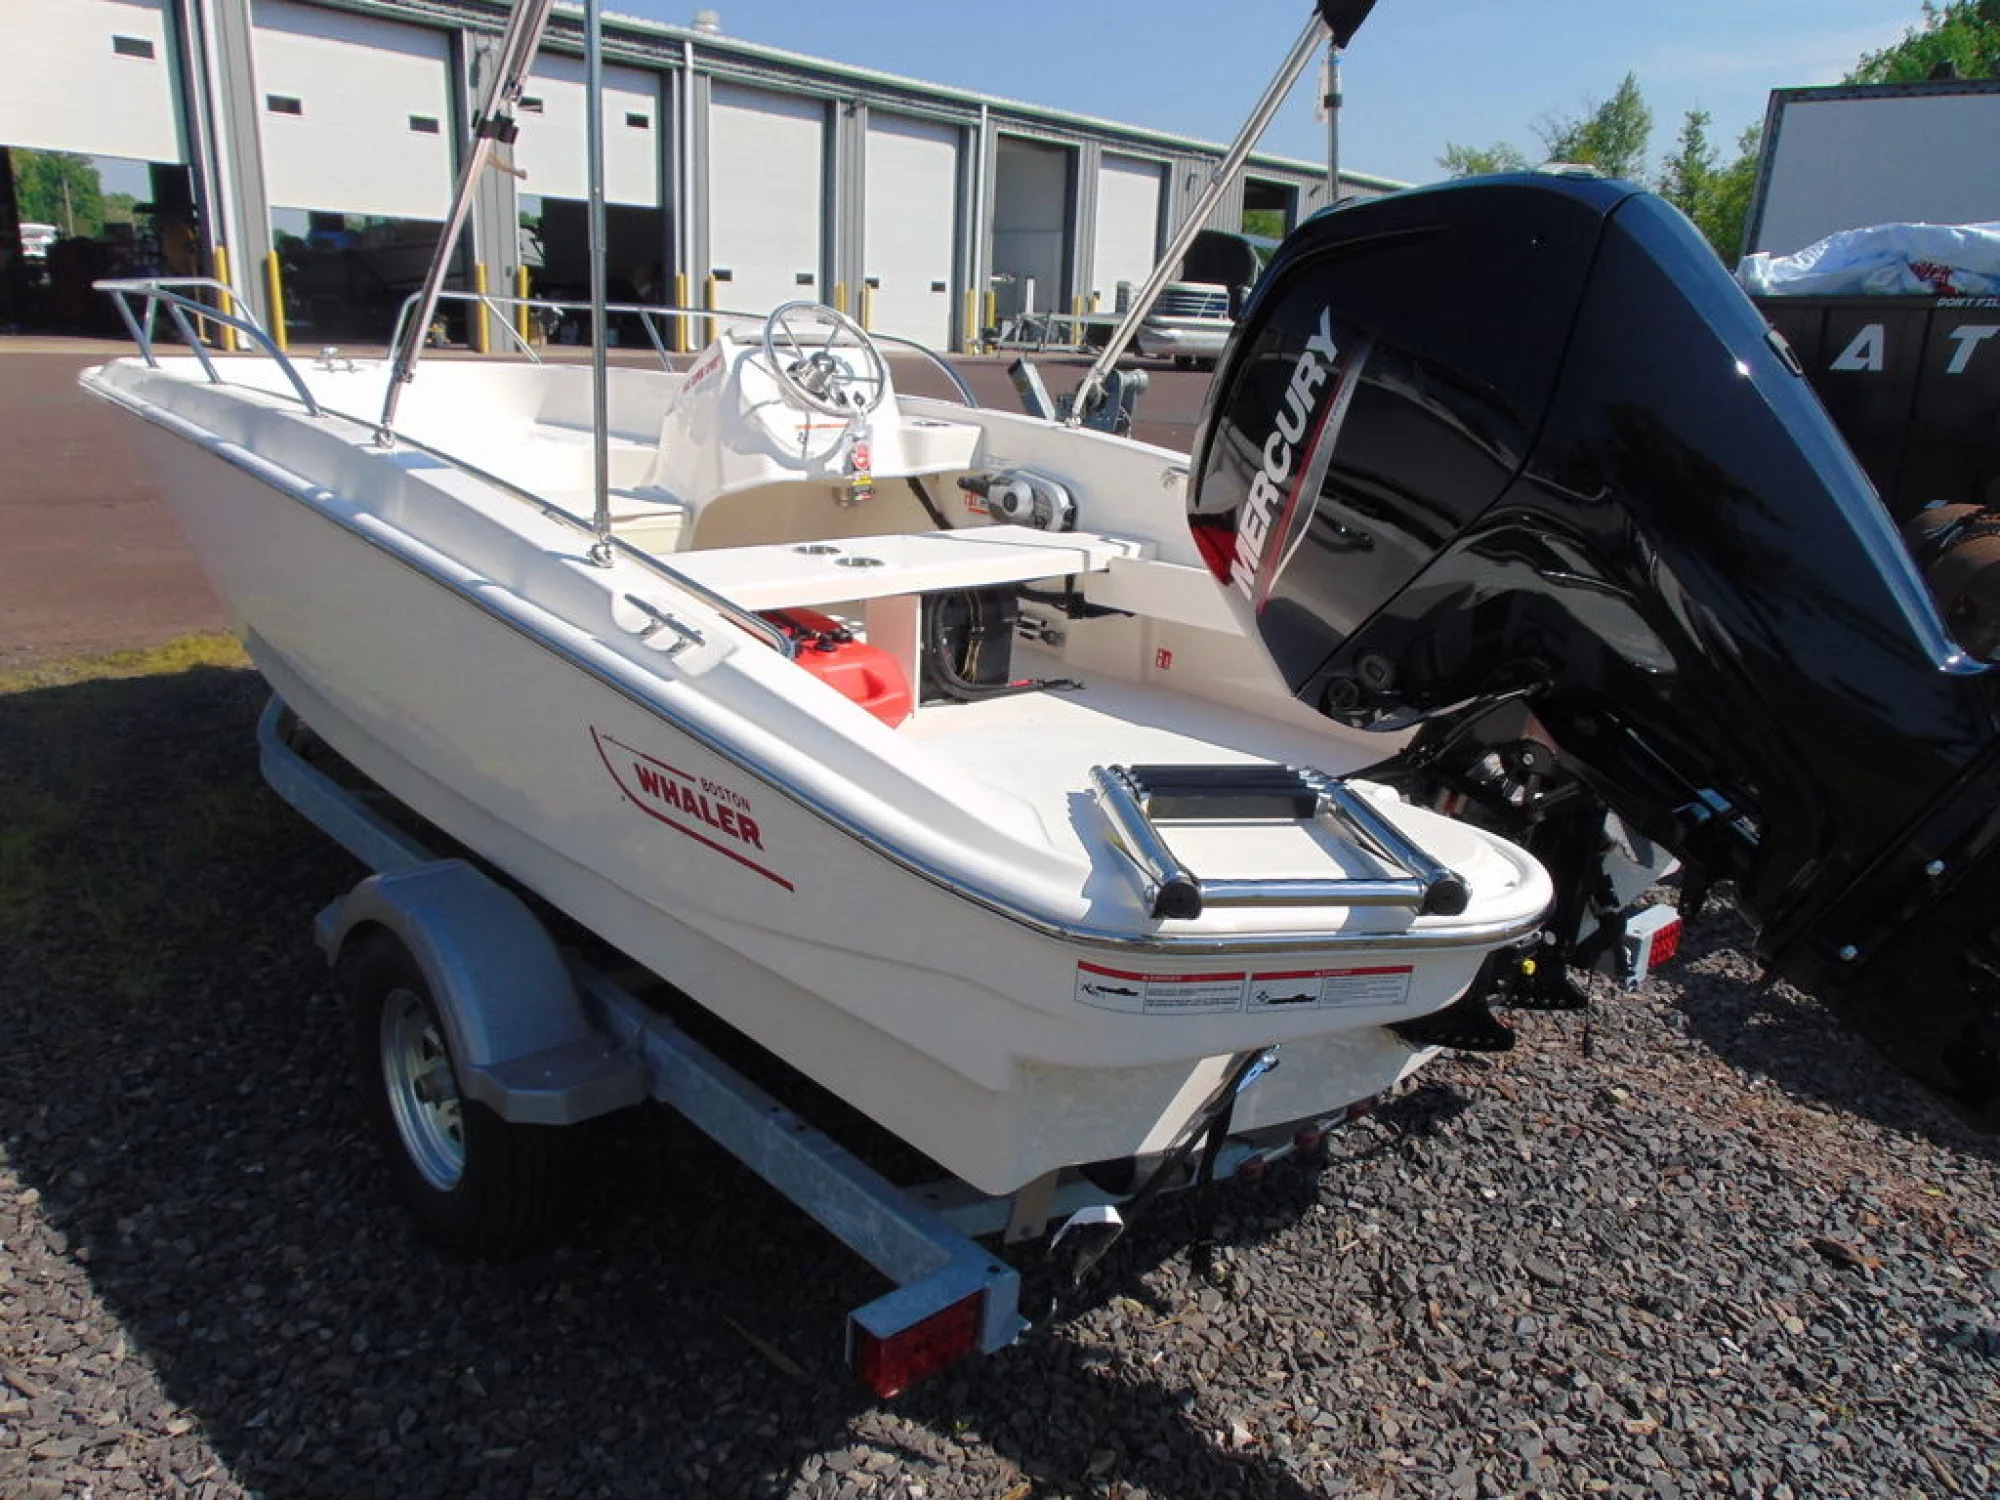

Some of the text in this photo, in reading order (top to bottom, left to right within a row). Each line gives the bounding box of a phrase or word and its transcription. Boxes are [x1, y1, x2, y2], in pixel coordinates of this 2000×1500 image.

[1230, 304, 1338, 601] MERCURY
[632, 762, 765, 851] WHALER
[700, 776, 751, 812] BOSTON
